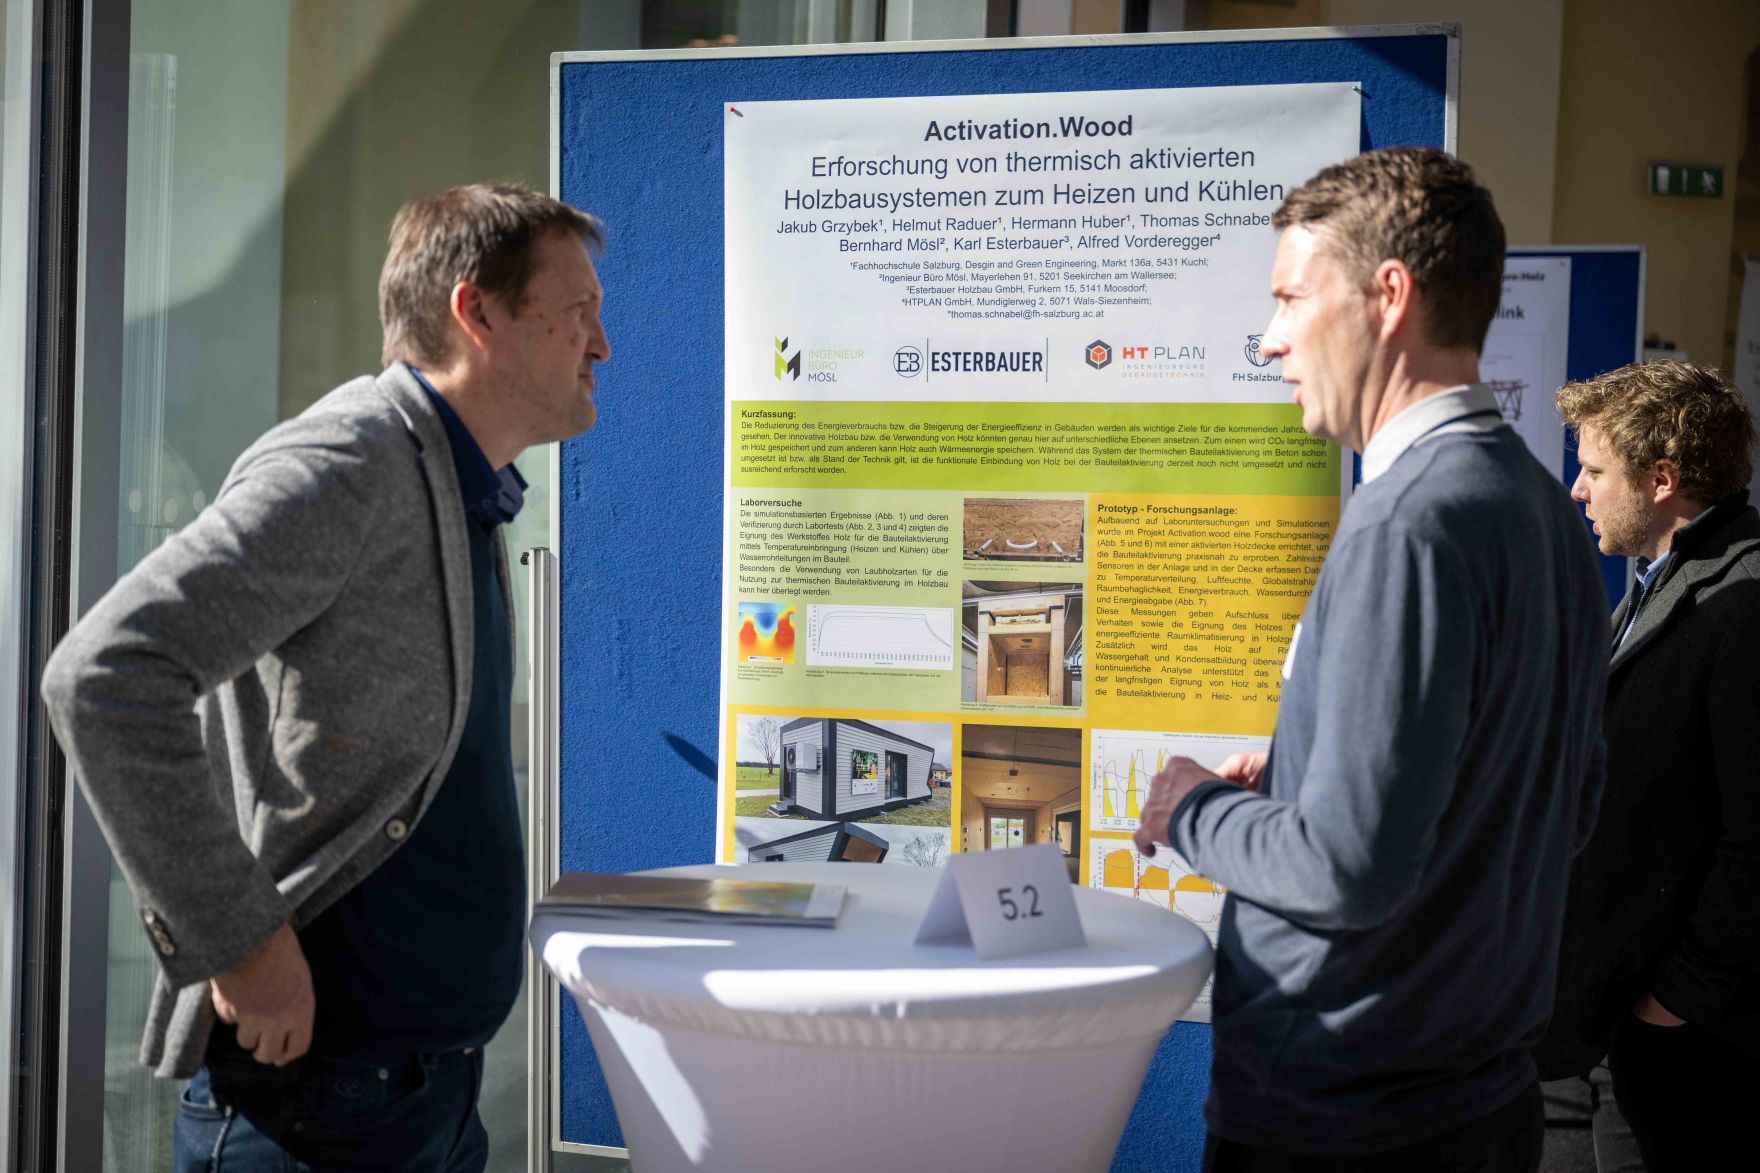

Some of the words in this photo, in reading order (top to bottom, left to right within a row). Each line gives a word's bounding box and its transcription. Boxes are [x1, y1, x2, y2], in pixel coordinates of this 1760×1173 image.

[925, 115, 1132, 141] Activation.Wood
[812, 155, 948, 179] Erforschung
[956, 157, 997, 173] von
[1006, 150, 1121, 172] thermisch
[1130, 148, 1254, 169] aktivierten
[785, 188, 986, 213] Holzbausystemen
[995, 189, 1044, 206] zum
[1054, 184, 1135, 204] Heizen
[1145, 181, 1189, 203] und
[1199, 180, 1284, 202] Kühlen
[777, 221, 817, 234] Jakub
[892, 219, 942, 232] Helmut
[1012, 217, 1077, 230] Hermann
[1140, 214, 1200, 227] Thomas
[1204, 213, 1273, 227] Schnabe
[840, 239, 903, 252] Bernhard
[954, 237, 981, 251] Karl
[1077, 235, 1119, 249] Alfred
[923, 261, 963, 270] Salzburg,
[965, 260, 995, 270] Desgin
[997, 260, 1014, 269] and
[1015, 260, 1043, 269] Green
[1045, 260, 1099, 269] Engineering,
[1102, 259, 1127, 267] Markt
[1130, 258, 1154, 267] 136a,
[1157, 258, 1178, 267] 5431
[1181, 258, 1209, 267] Kuchl;
[923, 273, 944, 282] Büro
[946, 273, 969, 282] Mösl,
[971, 273, 1021, 282] Mayerlehen
[1023, 272, 1037, 281] 91,
[1039, 272, 1060, 281] 5201
[1063, 272, 1112, 281] Seekirchen
[1130, 271, 1177, 280] Wallersee;
[958, 286, 993, 294] Holzbau
[995, 285, 1025, 294] GmbH,
[1028, 284, 1061, 293] Furkern
[1065, 284, 1077, 293] 15,
[1080, 284, 1101, 293] 5141
[1104, 284, 1148, 293] Moosdorf;
[944, 298, 974, 306] GmbH,
[977, 298, 1037, 307] Mundiglerweg
[1039, 297, 1047, 306] 2,
[1049, 297, 1070, 306] 5071
[1073, 297, 1152, 305] Wals-Siezenheim;
[808, 350, 864, 359] INGENIEUR
[1123, 347, 1149, 359] HT
[1154, 346, 1205, 359] PLAN
[808, 360, 838, 371] BÜRO
[931, 351, 1043, 372] ESTERBAUER
[808, 371, 838, 382] MÖSL
[1232, 373, 1245, 381] FH
[741, 410, 796, 419] Kurzfassung:
[741, 421, 753, 429] Die
[754, 421, 800, 431] Reduzierung
[801, 422, 816, 430] des
[818, 422, 888, 431] Energieverbrauchs
[909, 423, 921, 431] die
[923, 423, 964, 432] Steigerung
[981, 423, 1042, 432] Energieeffizienz
[1054, 424, 1095, 432] Gebäuden
[1143, 425, 1175, 433] wichtige
[1178, 424, 1198, 433] Ziele
[1200, 425, 1211, 433] für
[1213, 425, 1226, 433] die
[783, 466, 816, 474] erforscht
[817, 466, 847, 474] worden.
[740, 499, 802, 507] Laborversuche
[740, 509, 751, 517] Die
[754, 511, 827, 519] simulationsbasierten
[830, 511, 872, 521] Ergebnisse
[875, 512, 895, 520] (Abb.
[899, 513, 907, 522] 1)
[909, 513, 924, 521] und
[1097, 504, 1138, 515] Prototyp
[1147, 505, 1238, 516] Forschungsanlage:
[739, 521, 782, 530] Verifizierung
[805, 522, 844, 530] Labortests
[846, 523, 865, 531] (Abb.
[867, 522, 875, 531] 2,
[876, 523, 882, 531] 3
[898, 524, 907, 533] 4)
[908, 525, 936, 533] zeigten
[1097, 516, 1140, 525] Aufbauend
[1145, 517, 1158, 525] auf
[1163, 518, 1250, 528] Laboruntersuchungen
[1276, 520, 1331, 529] Simulationen
[739, 531, 767, 541] Eignung
[787, 533, 830, 541] Werkstoffes
[834, 534, 851, 542] Holz
[854, 534, 865, 542] für
[867, 534, 880, 542] die
[883, 535, 949, 545] Bauteilaktivierung
[1097, 528, 1121, 536] wurde
[1137, 528, 1165, 538] Projekt
[1167, 529, 1230, 538] Activation.wood
[1254, 530, 1331, 542] Forschungsanlage
[764, 543, 847, 554] Temperatureinbringung
[850, 545, 879, 553] (Heizen
[899, 546, 929, 555] Kühlen)
[931, 547, 949, 555] über
[1097, 539, 1118, 547] (Abb.
[1120, 539, 1126, 547] 5
[1127, 540, 1143, 548] und
[1144, 540, 1153, 549] 6)
[1168, 541, 1189, 549] einer
[1234, 542, 1276, 551] Holzdecke
[1278, 543, 1314, 551] errichtet,
[1316, 542, 1330, 553] um
[739, 554, 811, 563] Wasserrohrleitungen
[823, 555, 850, 563] Bauteil.
[997, 885, 1043, 921] 5.2
